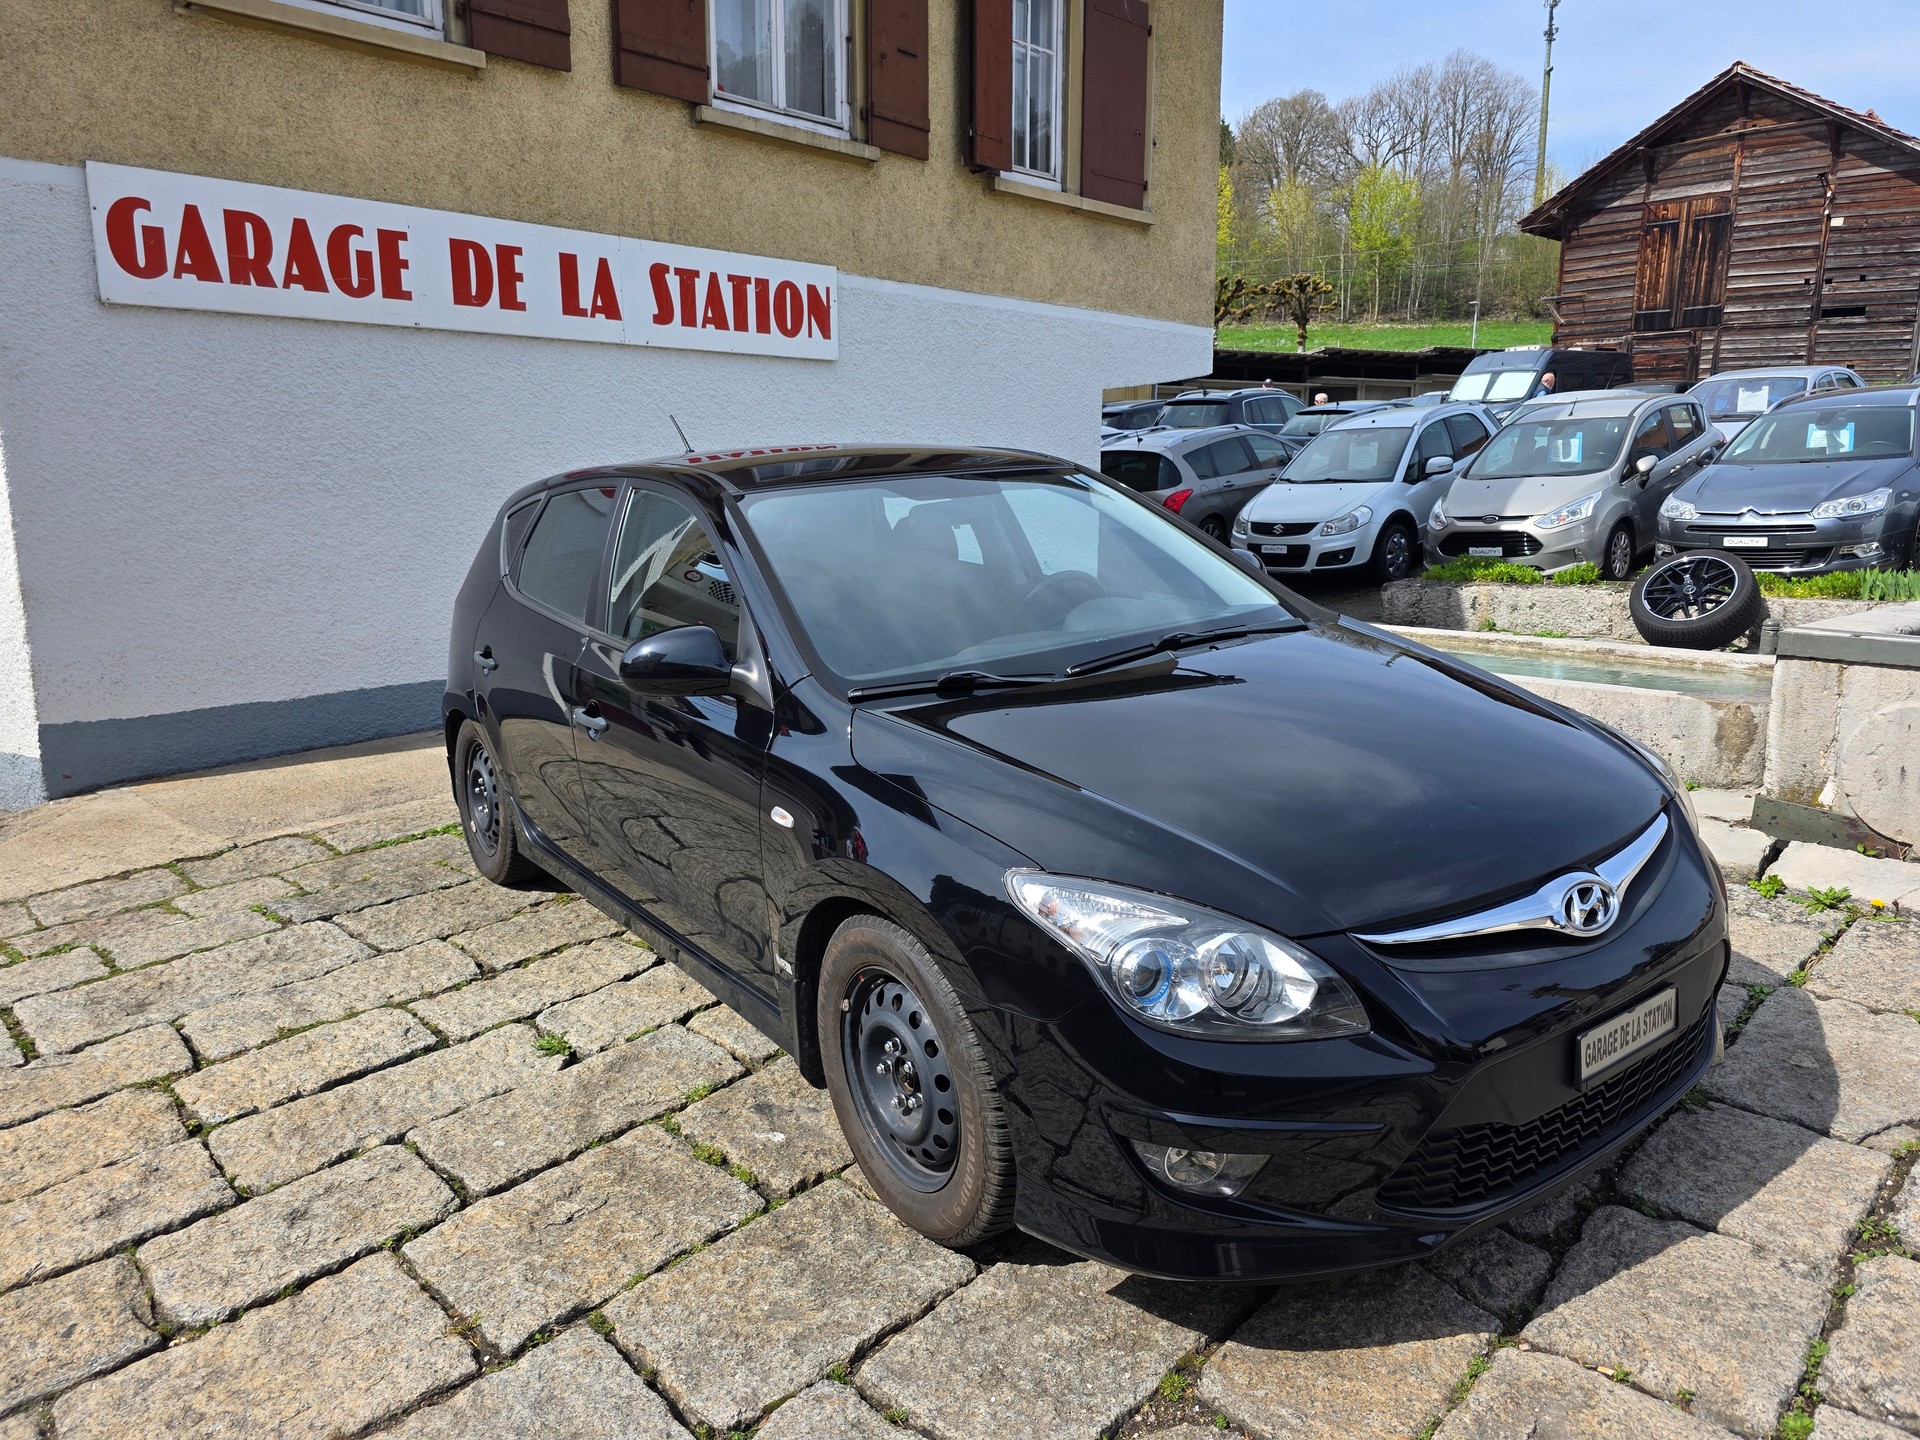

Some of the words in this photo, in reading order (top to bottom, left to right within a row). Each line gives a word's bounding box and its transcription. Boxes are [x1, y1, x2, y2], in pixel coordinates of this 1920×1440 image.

[106, 196, 412, 301] GARAGE
[449, 238, 526, 311] DE
[559, 252, 623, 321] LA
[650, 262, 832, 340] STATION
[1585, 1028, 1617, 1068] GARAGE
[1619, 1024, 1630, 1050] DE
[1631, 1015, 1642, 1043] LA
[1643, 998, 1672, 1036] STATION
